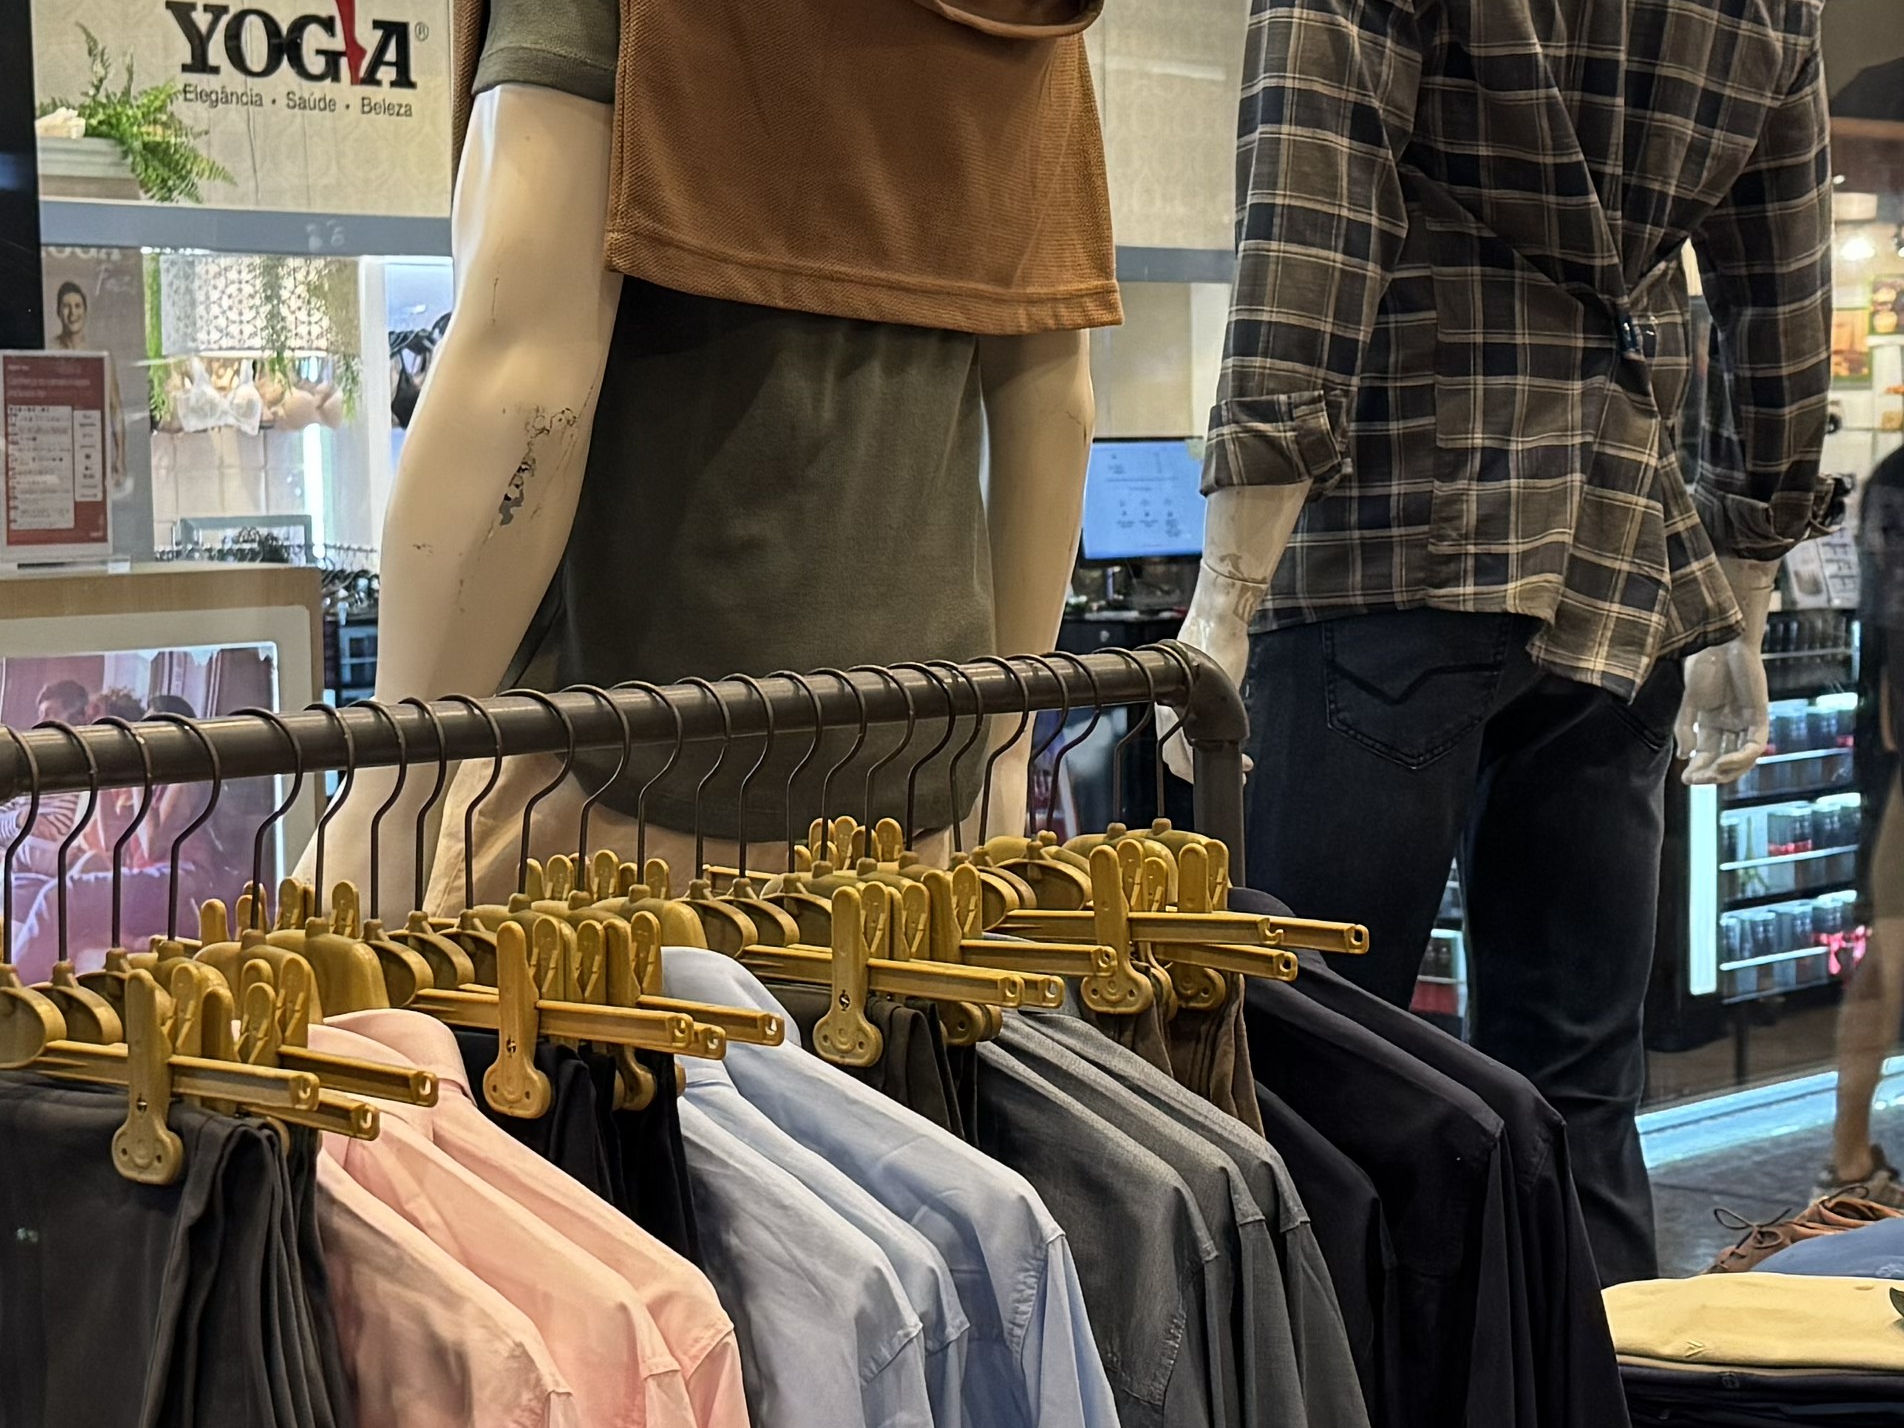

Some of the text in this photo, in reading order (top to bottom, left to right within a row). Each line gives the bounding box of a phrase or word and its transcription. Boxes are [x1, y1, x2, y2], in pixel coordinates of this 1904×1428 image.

[164, 0, 418, 90] YOGA
[182, 83, 414, 118] Elegância Saúde Beleza
